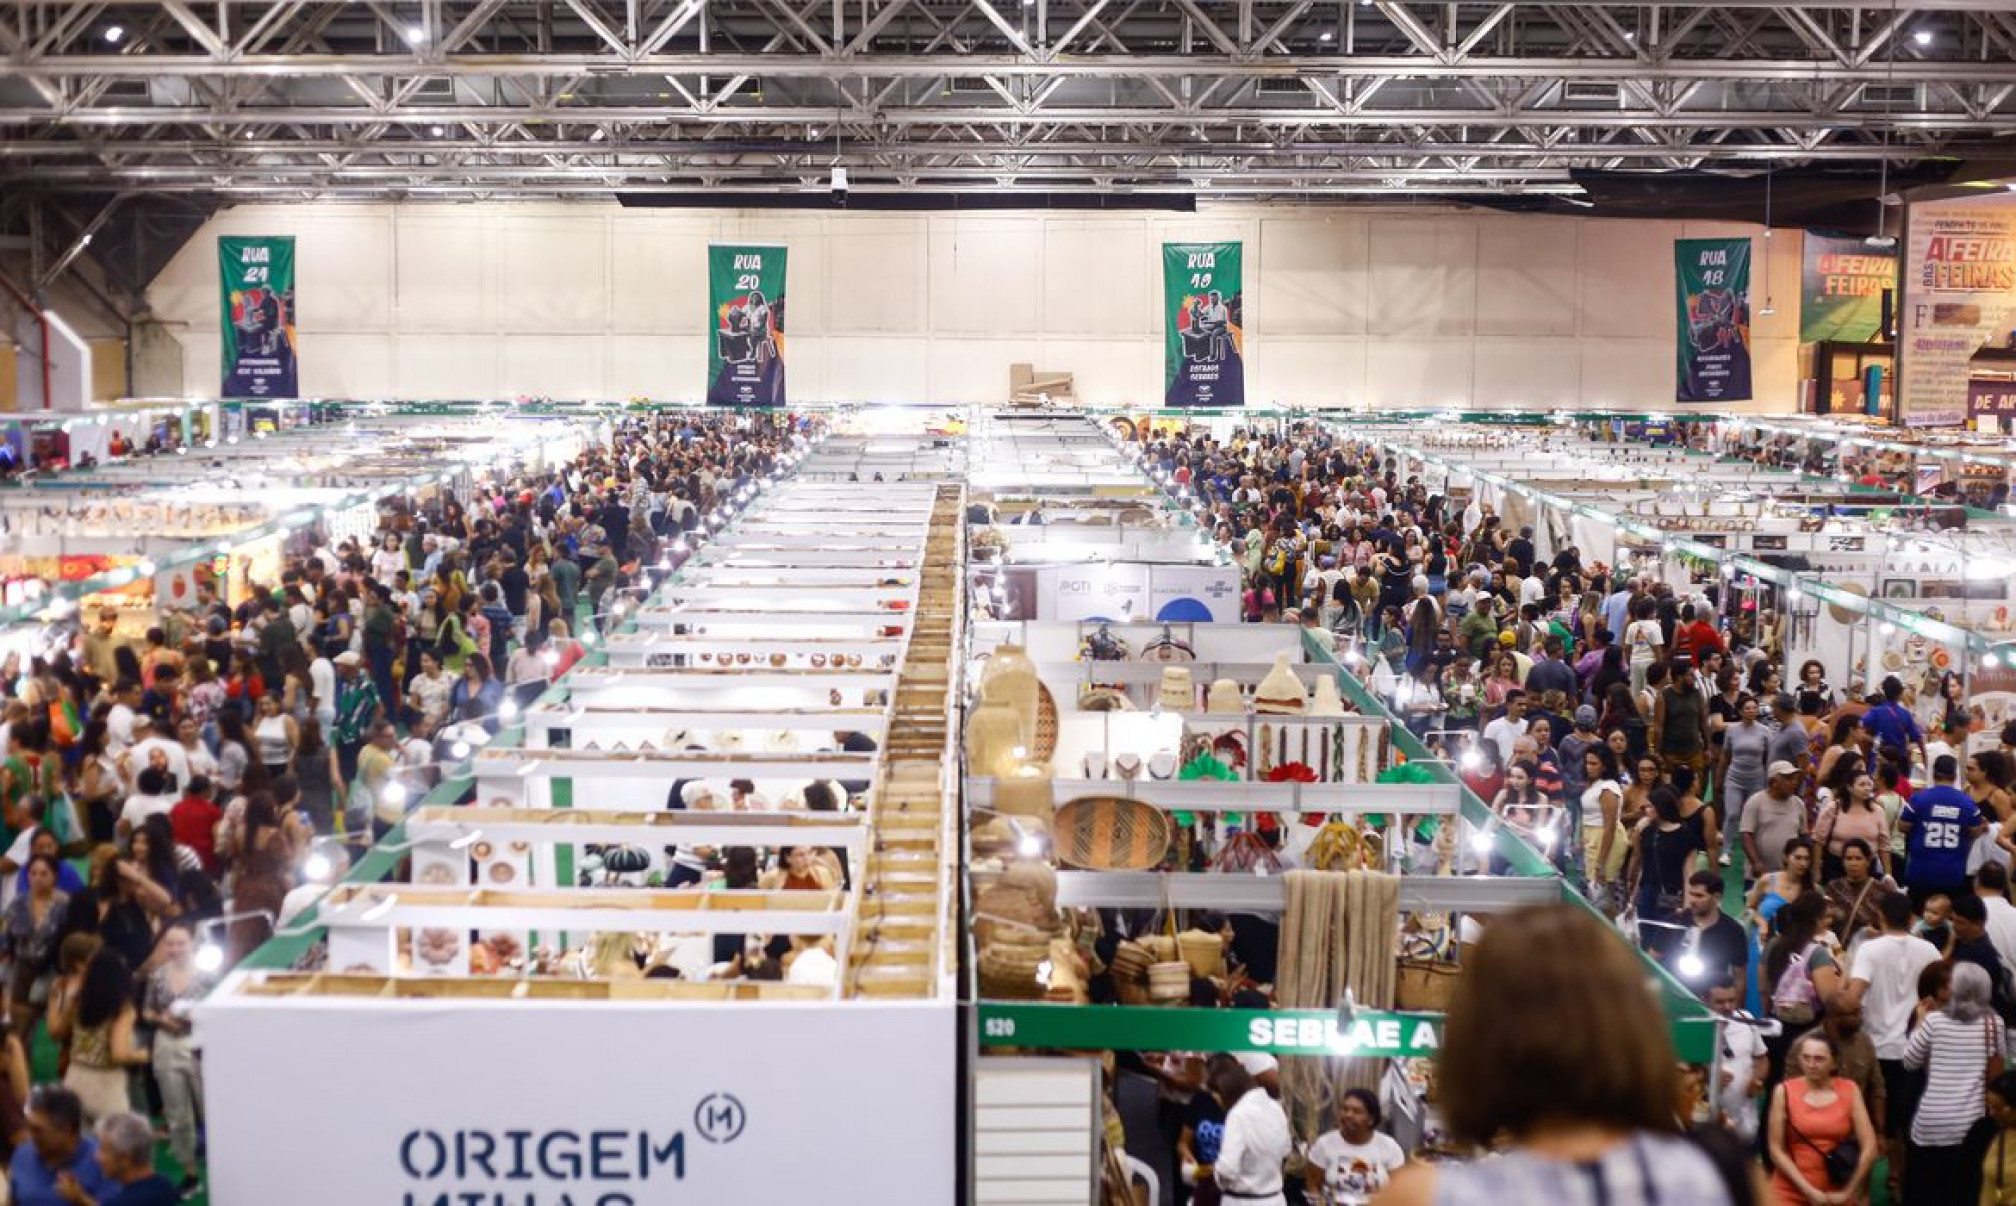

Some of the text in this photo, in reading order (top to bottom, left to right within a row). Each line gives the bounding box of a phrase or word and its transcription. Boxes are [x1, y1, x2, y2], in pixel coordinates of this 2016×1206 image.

[241, 247, 269, 263] RUA
[734, 254, 761, 270] RUA
[1187, 253, 1215, 268] RUA
[1700, 250, 1726, 266] RUA
[735, 275, 759, 290] 20
[1703, 270, 1723, 286] 18
[1935, 264, 2015, 289] FEIRAS
[1974, 394, 1994, 409] DE
[400, 1129, 685, 1180] ORIGEM
